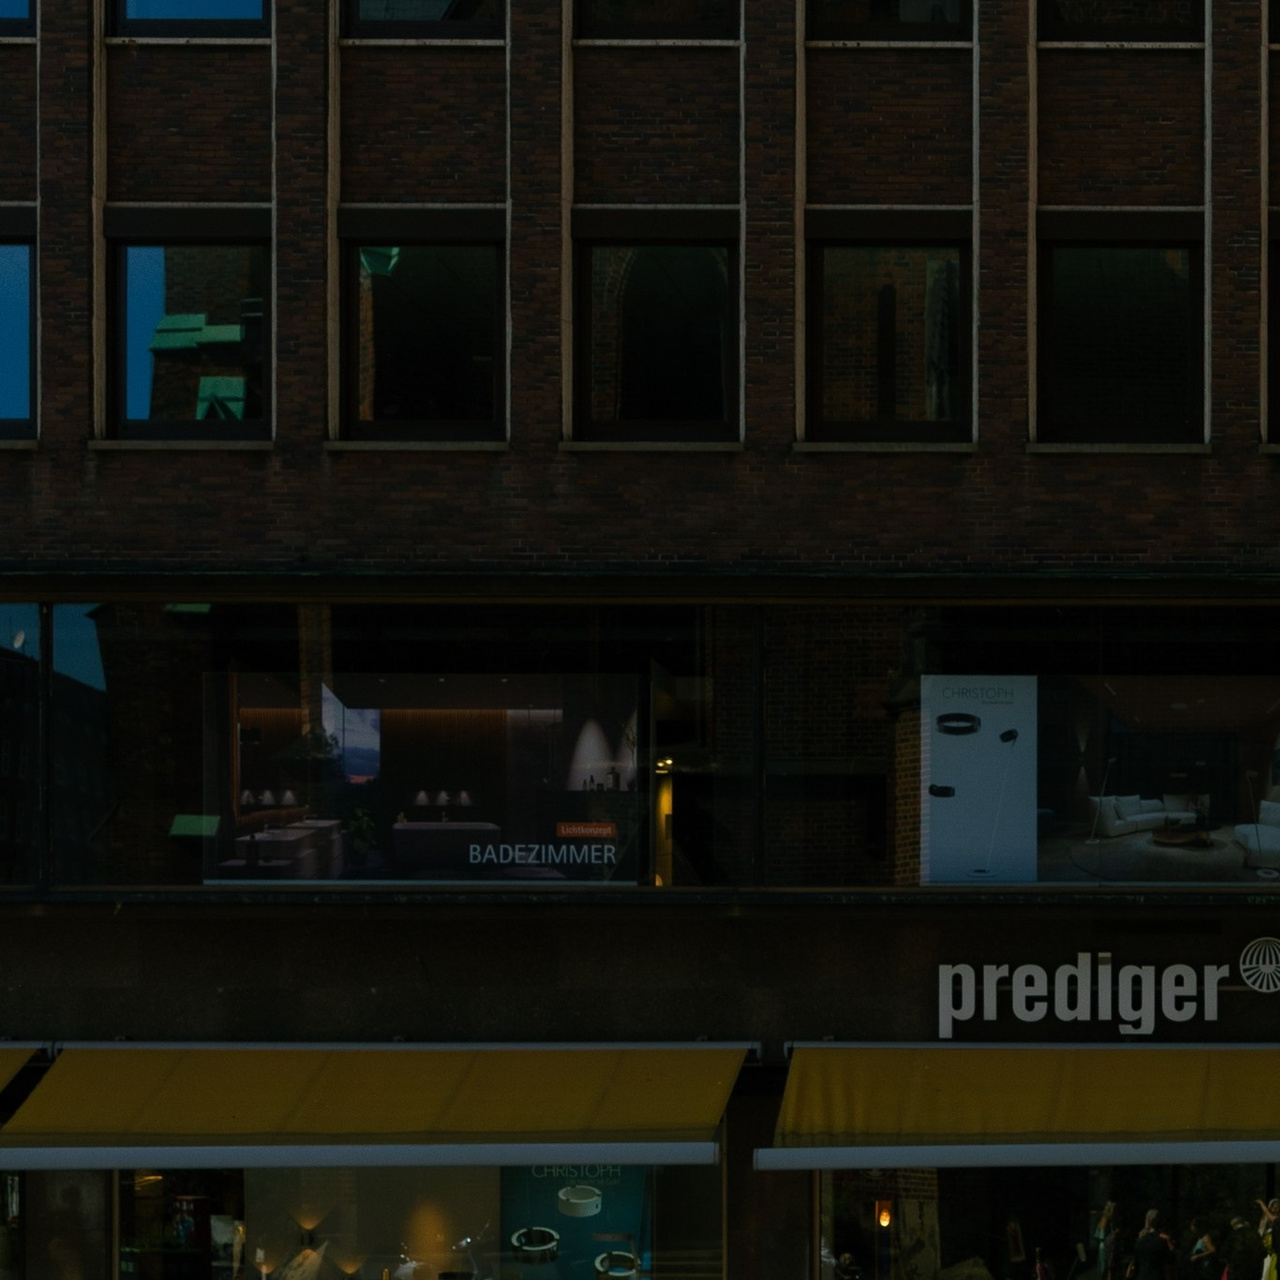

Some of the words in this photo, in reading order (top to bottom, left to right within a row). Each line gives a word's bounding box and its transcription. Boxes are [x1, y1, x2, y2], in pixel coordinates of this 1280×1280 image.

[941, 687, 1015, 700] CHRISTOPH
[561, 825, 612, 837] Lichtkonzept
[469, 844, 616, 865] BADEZIMMER
[938, 952, 1230, 1039] prediger
